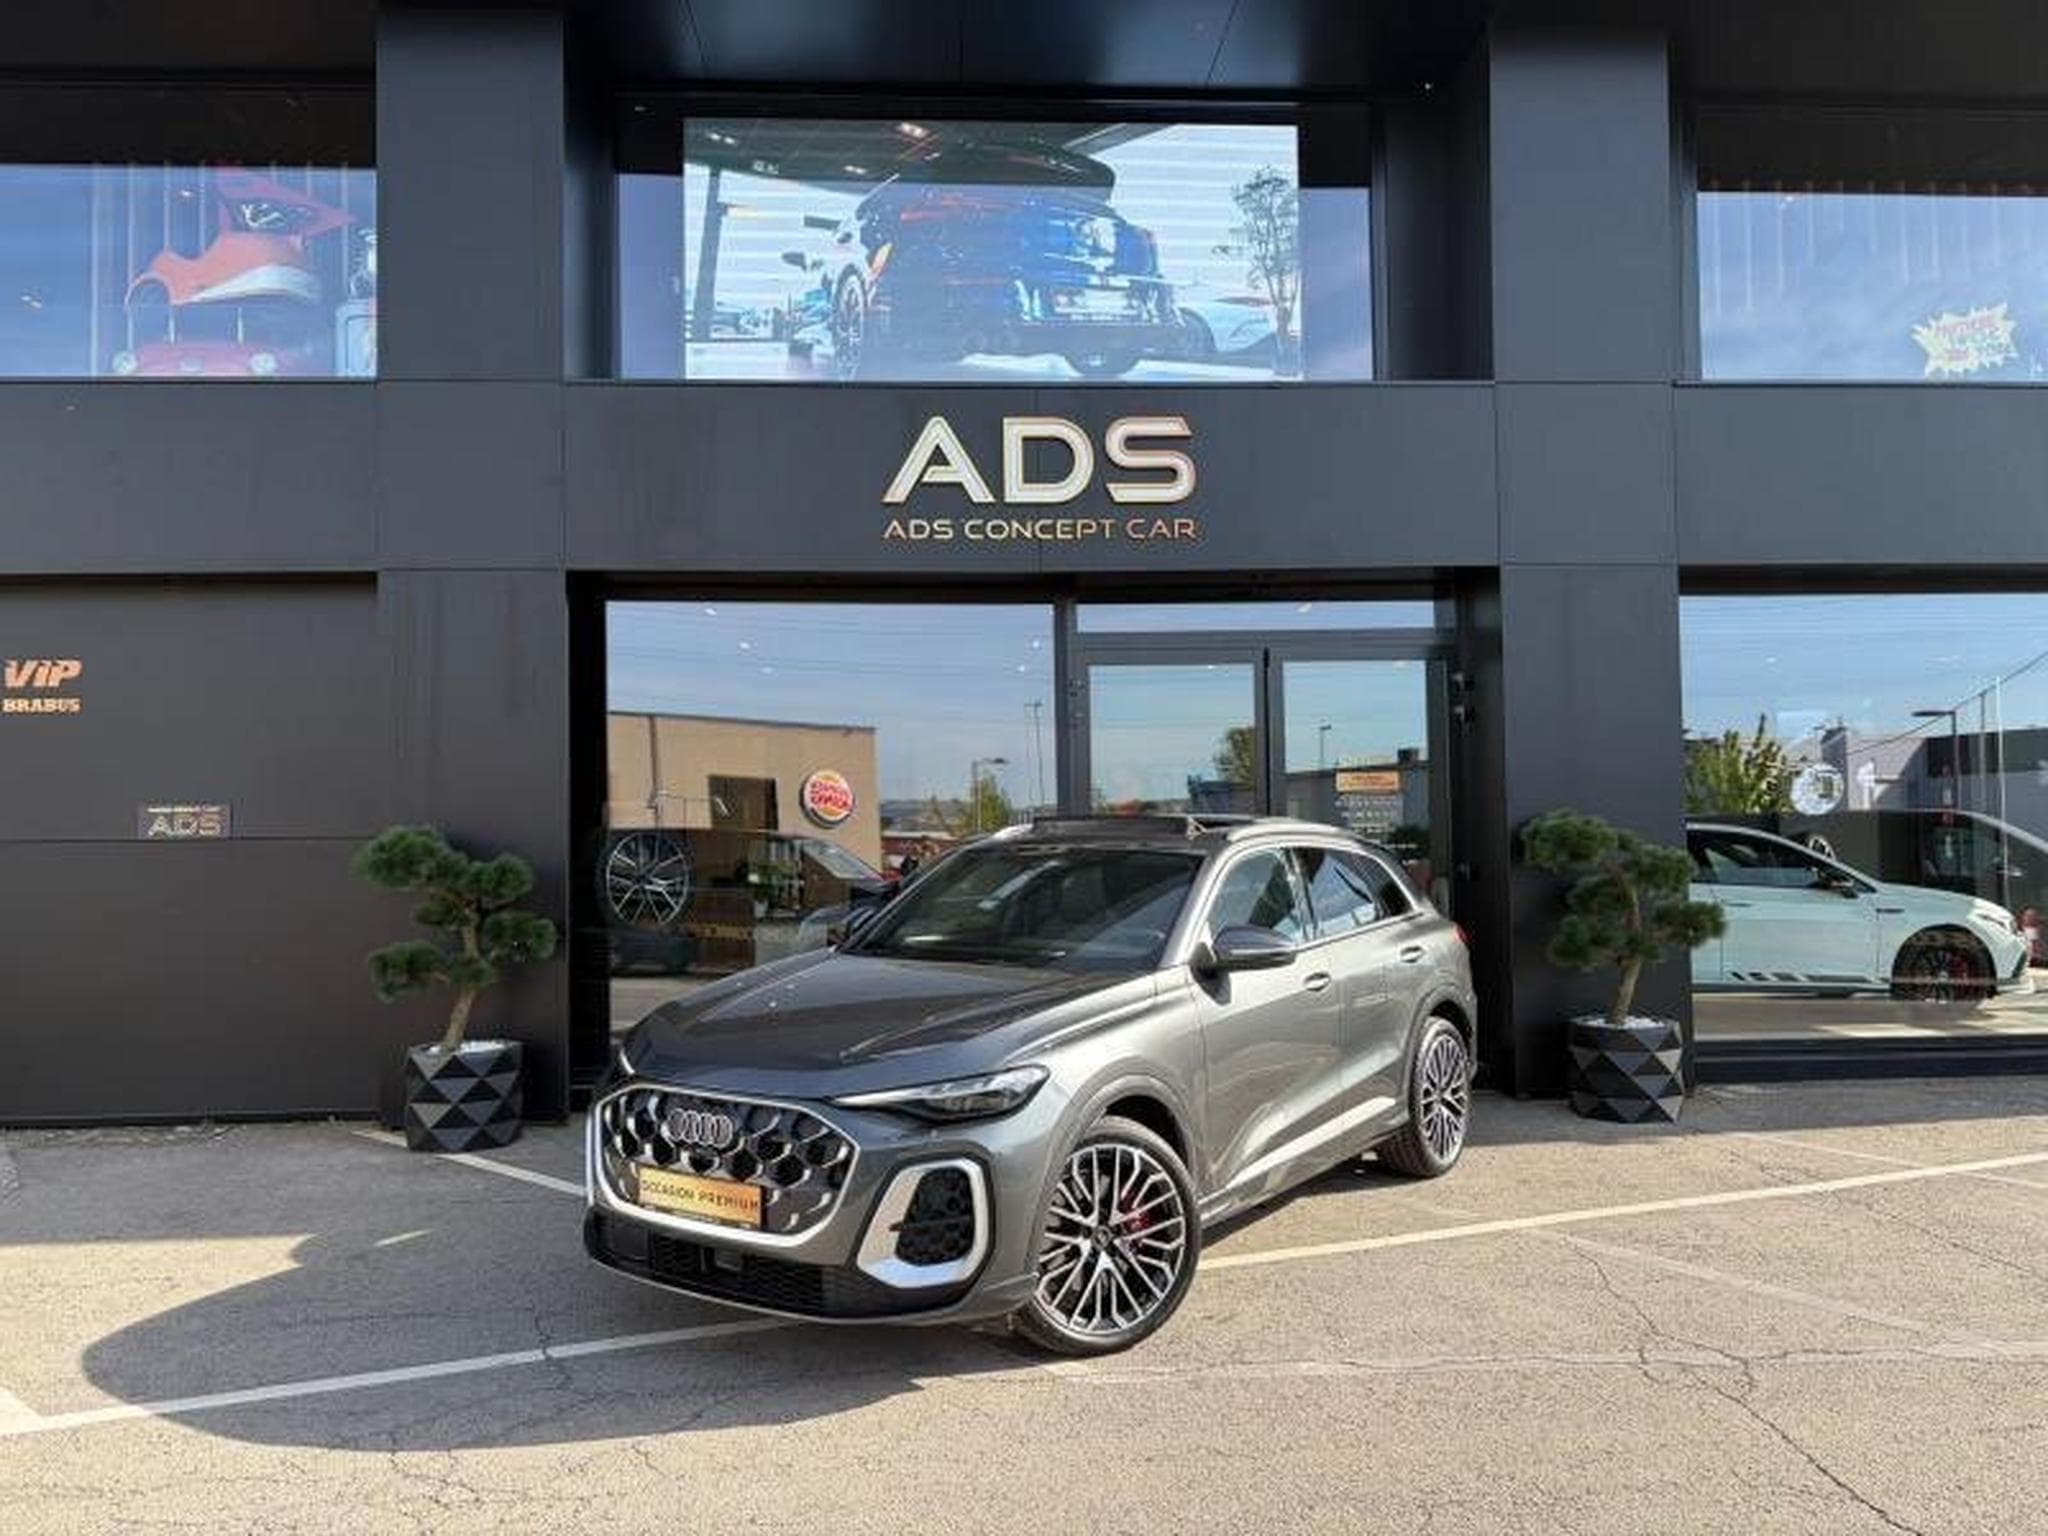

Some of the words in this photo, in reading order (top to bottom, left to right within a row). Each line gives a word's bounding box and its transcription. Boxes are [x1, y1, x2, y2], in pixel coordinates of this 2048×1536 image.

[881, 416, 1196, 503] ADS
[883, 518, 953, 540] ADS
[963, 518, 1115, 540] CONCEPT
[1125, 518, 1197, 540] CAR
[2, 698, 81, 713] BRABUS
[148, 815, 221, 837] ADS
[642, 1179, 694, 1200] OCCASION
[697, 1190, 759, 1211] PREMIUM
